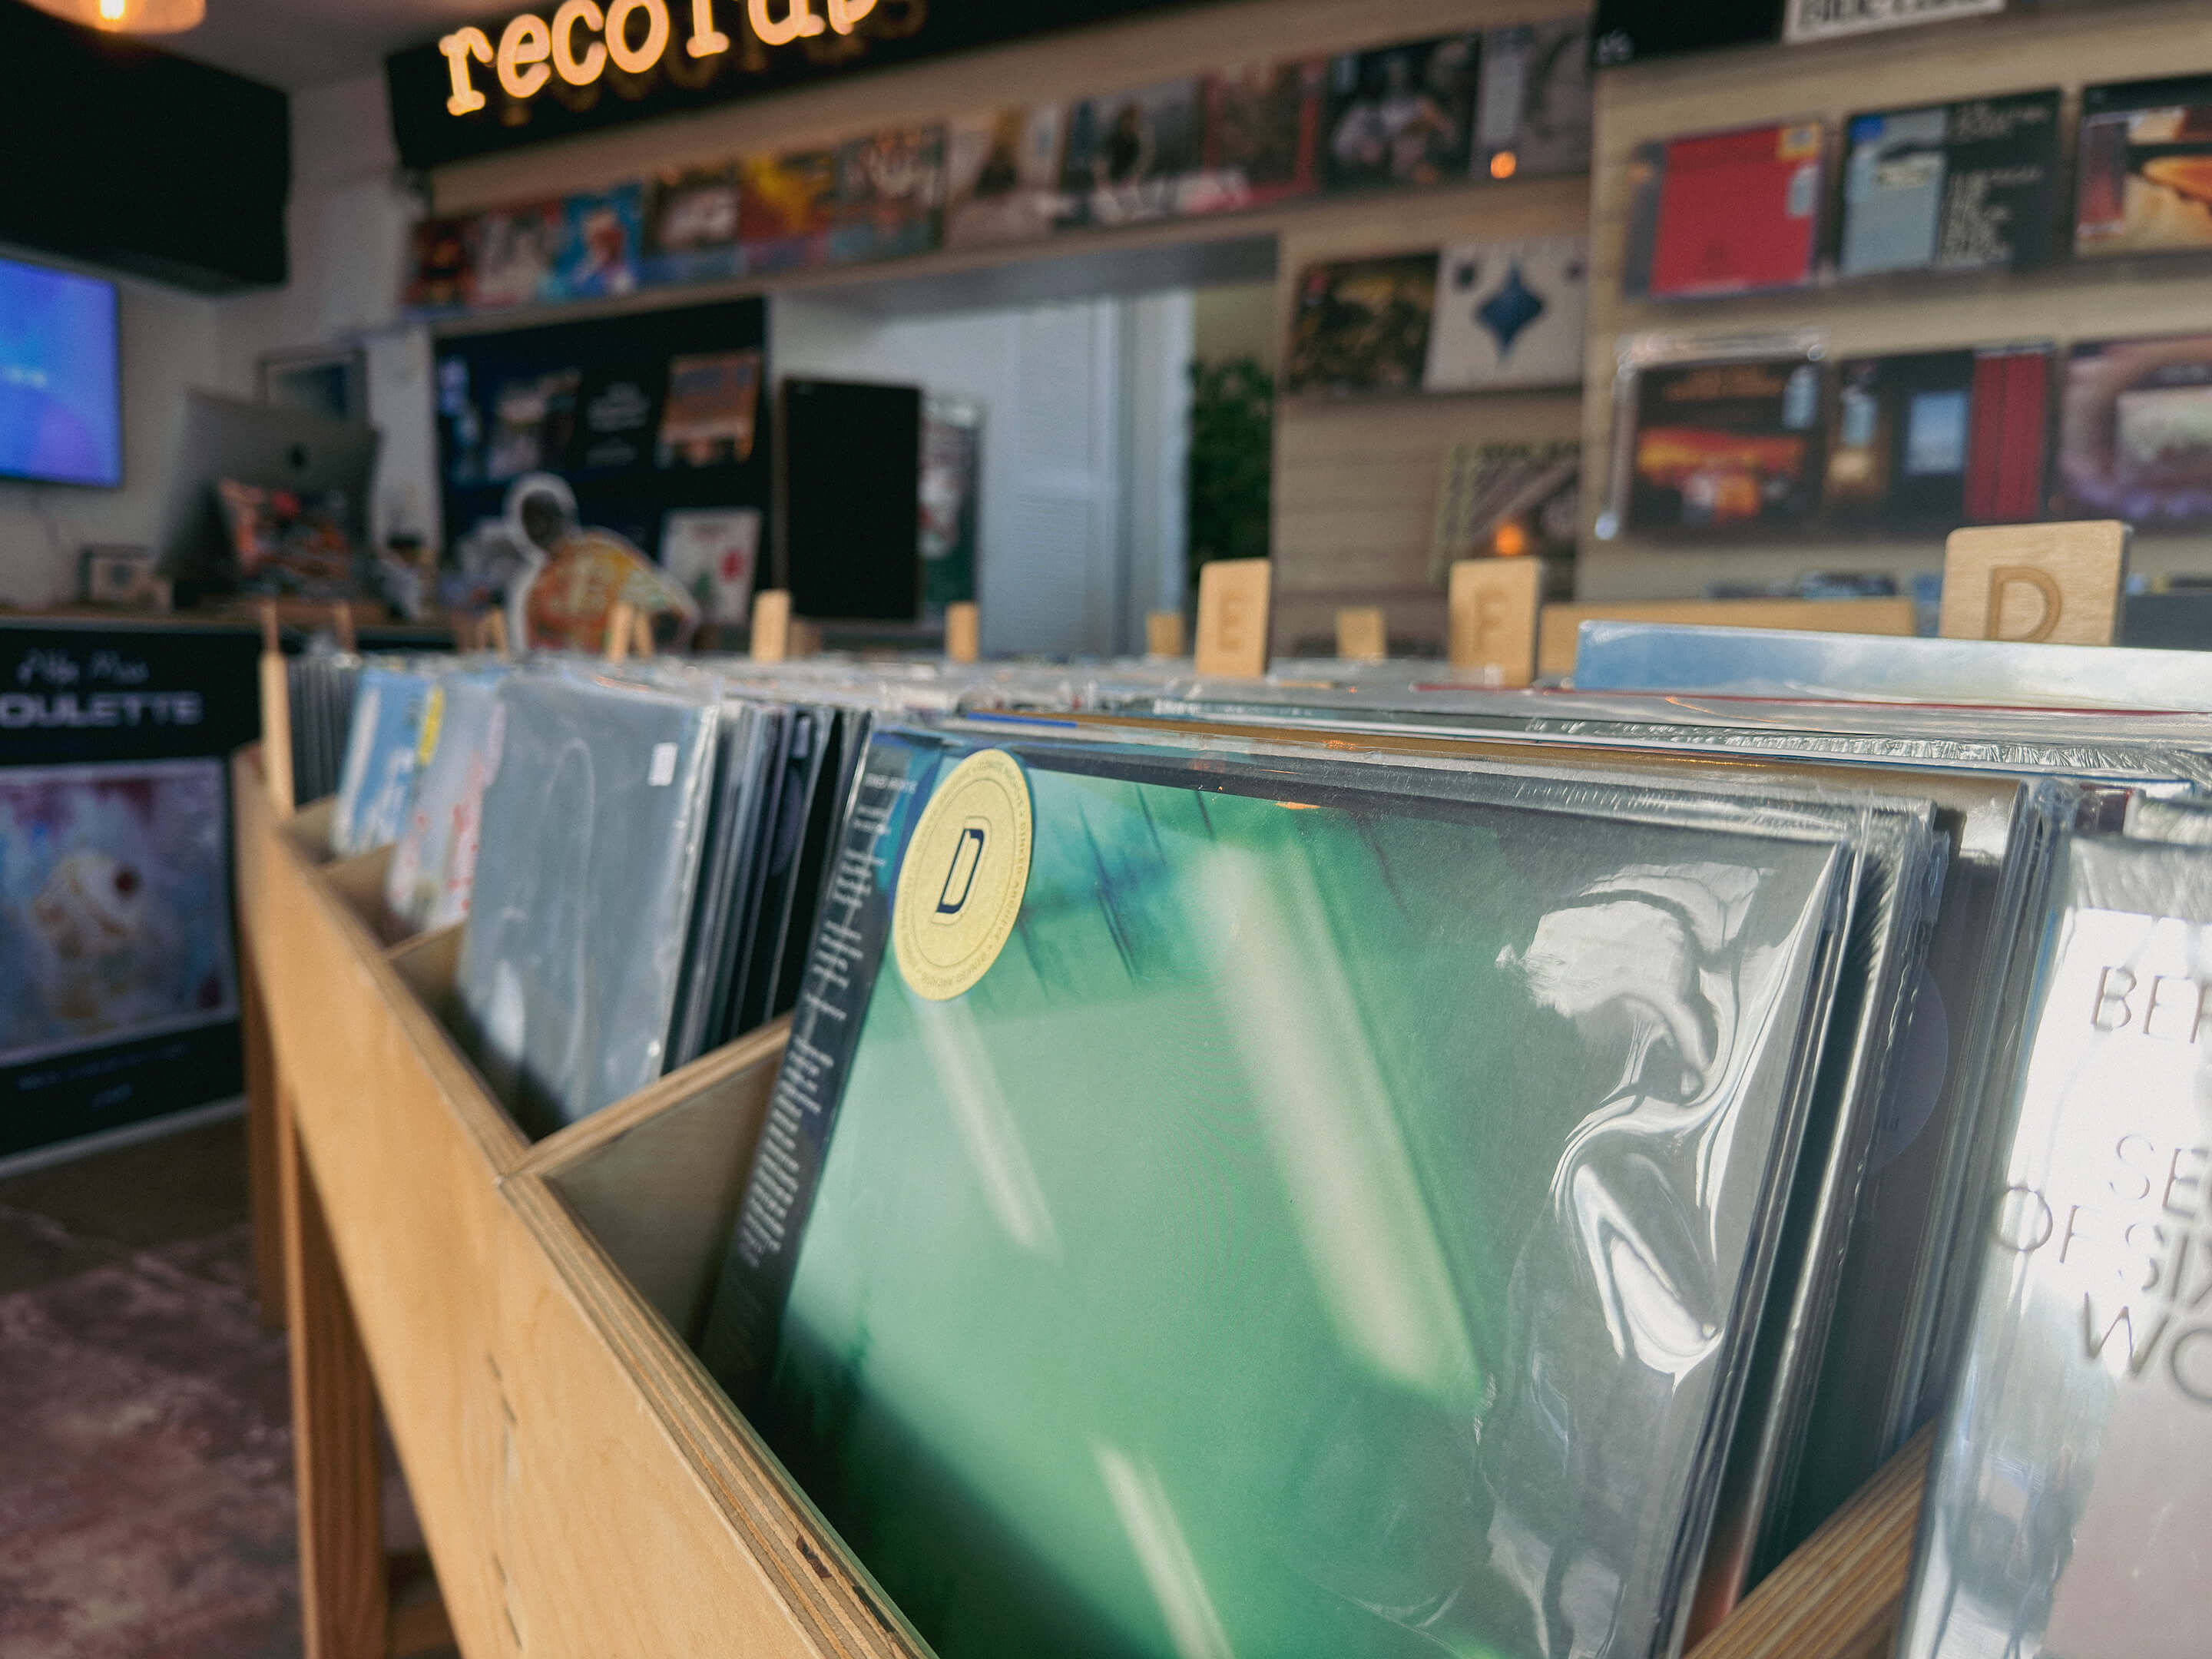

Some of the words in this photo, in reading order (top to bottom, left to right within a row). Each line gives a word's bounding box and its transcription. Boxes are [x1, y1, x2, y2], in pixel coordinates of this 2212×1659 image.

[1216, 589, 1243, 654] E
[1472, 588, 1505, 654] F
[1984, 565, 2062, 644] D
[935, 828, 985, 915] D
